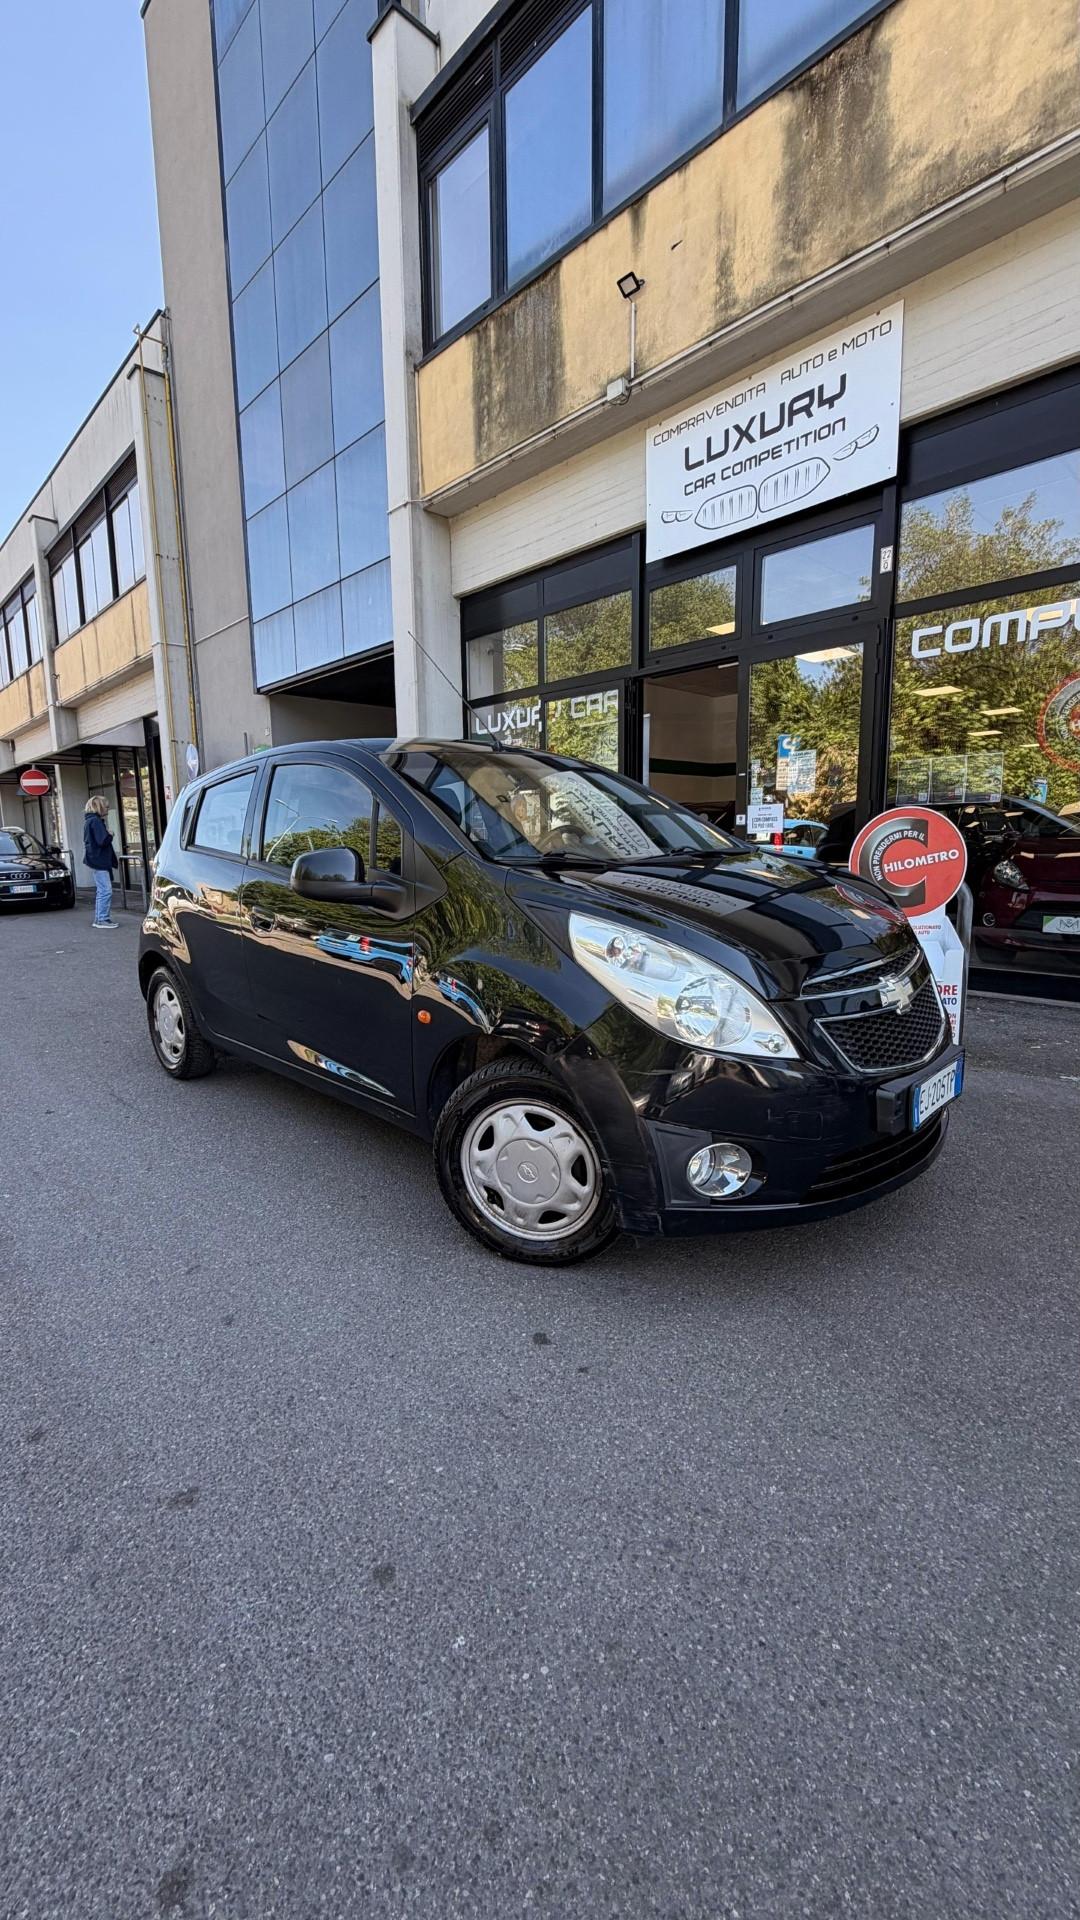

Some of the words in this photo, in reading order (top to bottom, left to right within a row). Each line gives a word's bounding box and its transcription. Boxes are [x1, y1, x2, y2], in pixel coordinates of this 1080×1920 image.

[653, 382, 766, 447] COMPRAVENDITA
[780, 352, 823, 385] AUTO
[827, 349, 838, 362] e
[841, 319, 892, 355] MOTO
[684, 373, 847, 471] LUXURY
[684, 472, 715, 496] CAR
[721, 416, 846, 481] COMPETITION
[903, 830, 918, 838] PER
[918, 833, 925, 841] IL
[872, 831, 902, 865] PRENDERMI
[873, 865, 882, 881] NON
[937, 985, 958, 996] ORE
[942, 997, 957, 1006] ATO
